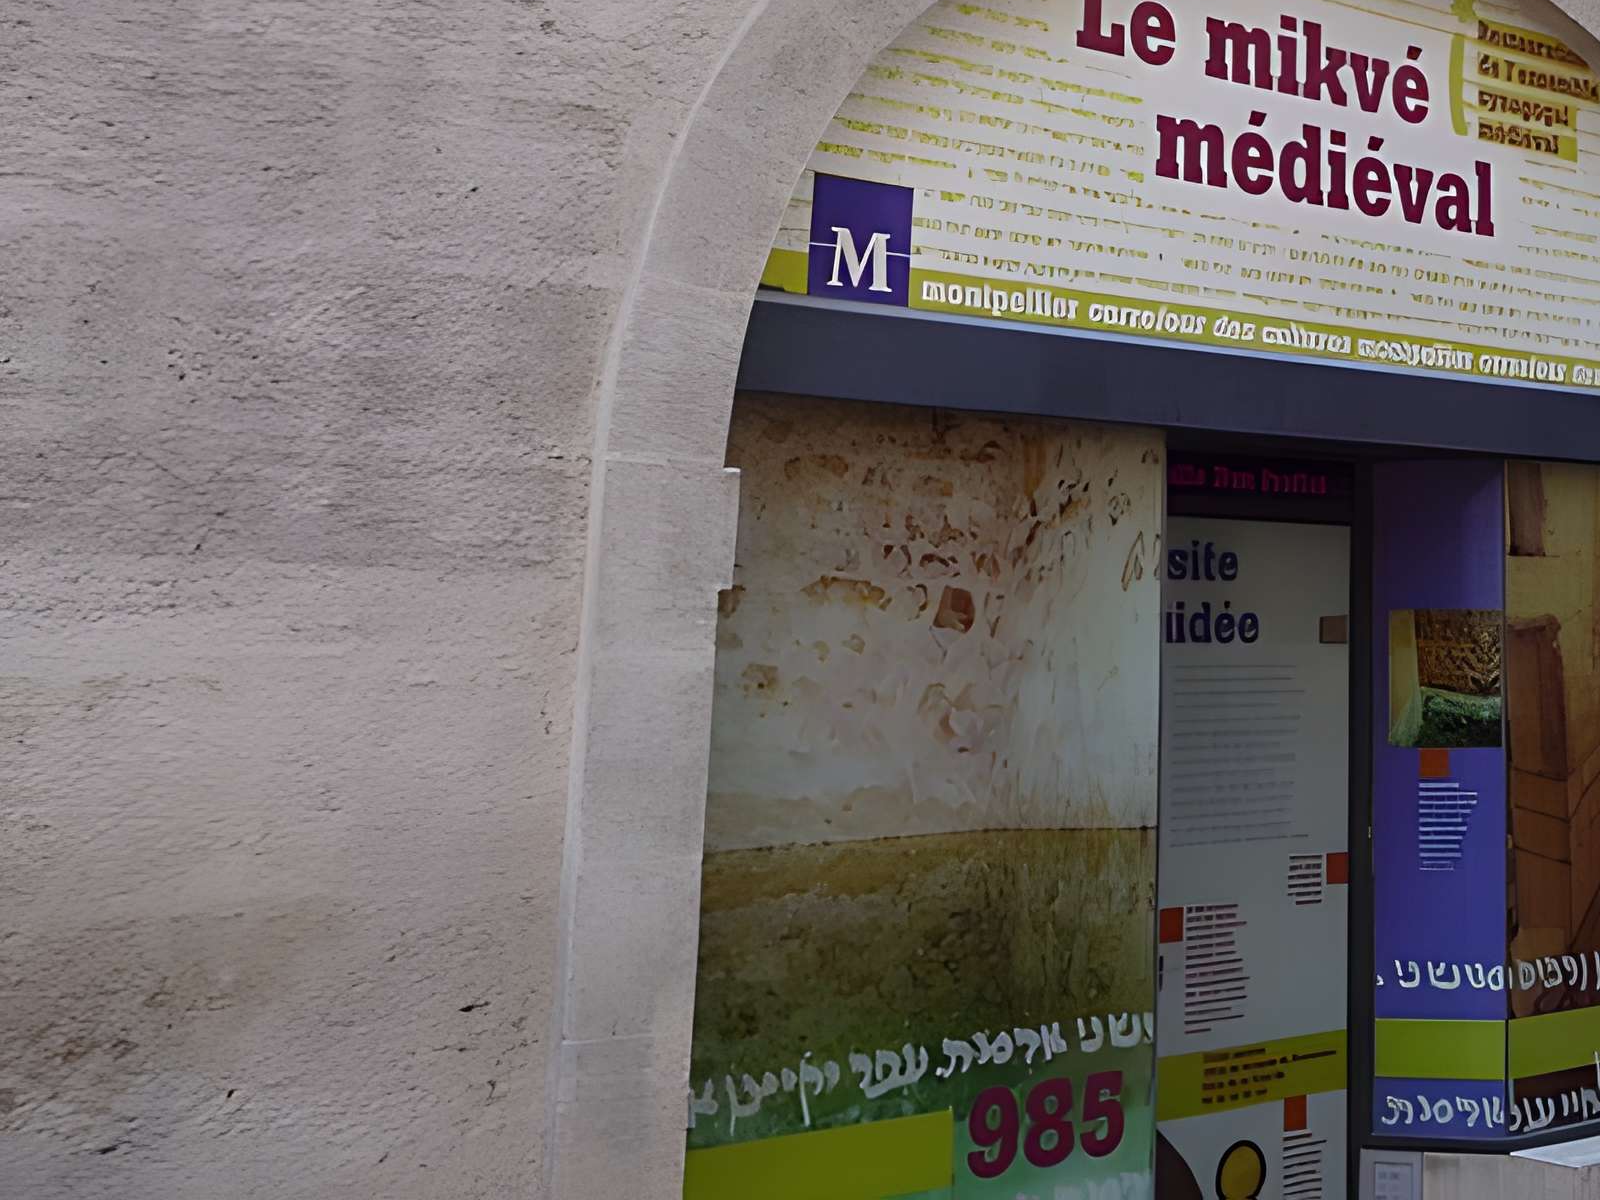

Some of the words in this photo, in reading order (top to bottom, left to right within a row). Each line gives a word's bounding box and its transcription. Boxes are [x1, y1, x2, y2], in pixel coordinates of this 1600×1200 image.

[1204, 14, 1430, 125] mikvé
[1155, 109, 1496, 238] médiéval
[826, 226, 893, 293] M
[967, 1069, 1126, 1179] 985
